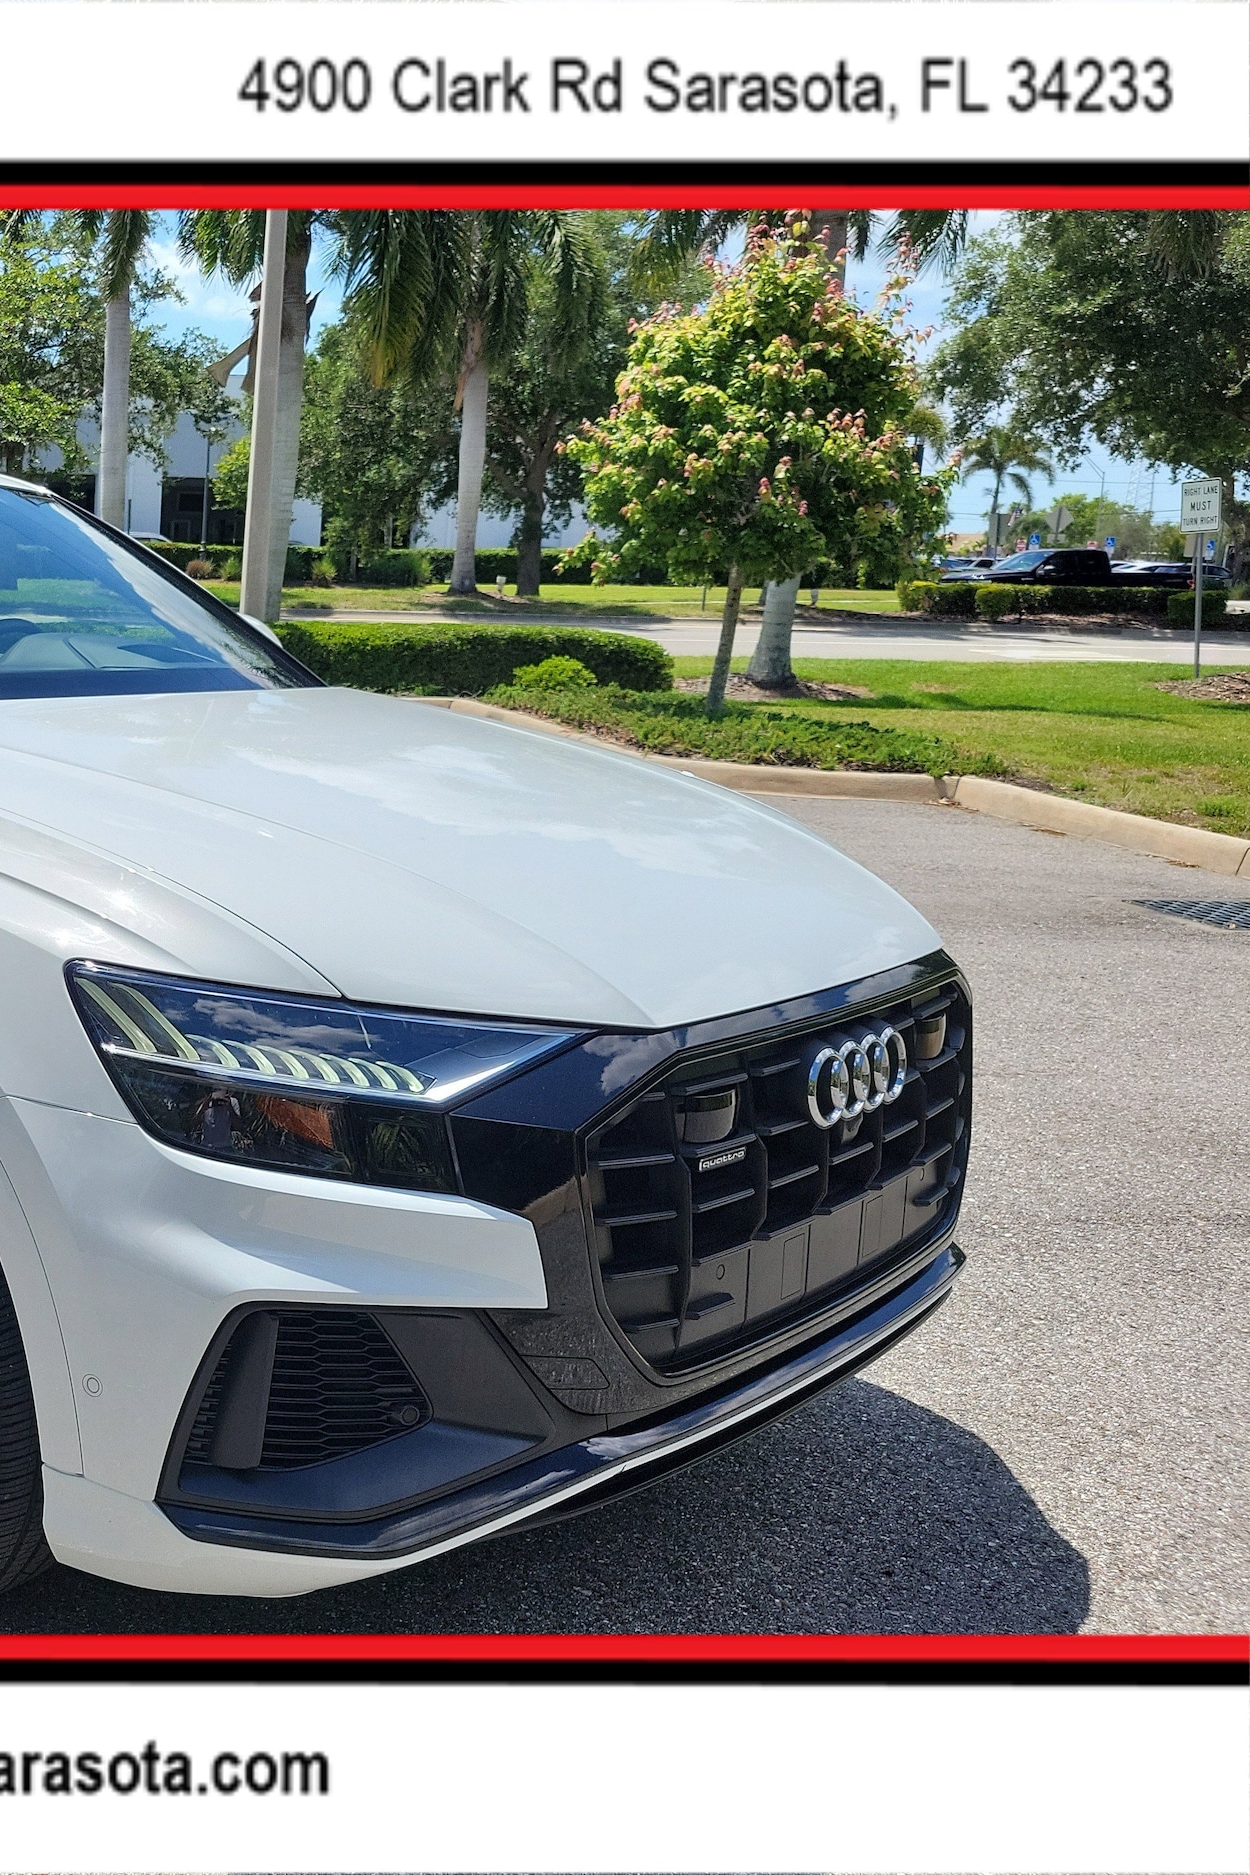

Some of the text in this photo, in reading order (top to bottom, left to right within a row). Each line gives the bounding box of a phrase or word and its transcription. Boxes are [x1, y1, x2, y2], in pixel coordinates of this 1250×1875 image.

[1183, 486, 1218, 496] RIGHT LANE
[1190, 500, 1212, 511] MUST
[1183, 515, 1218, 526] TURN RIGHT
[703, 1151, 744, 1168] quattro
